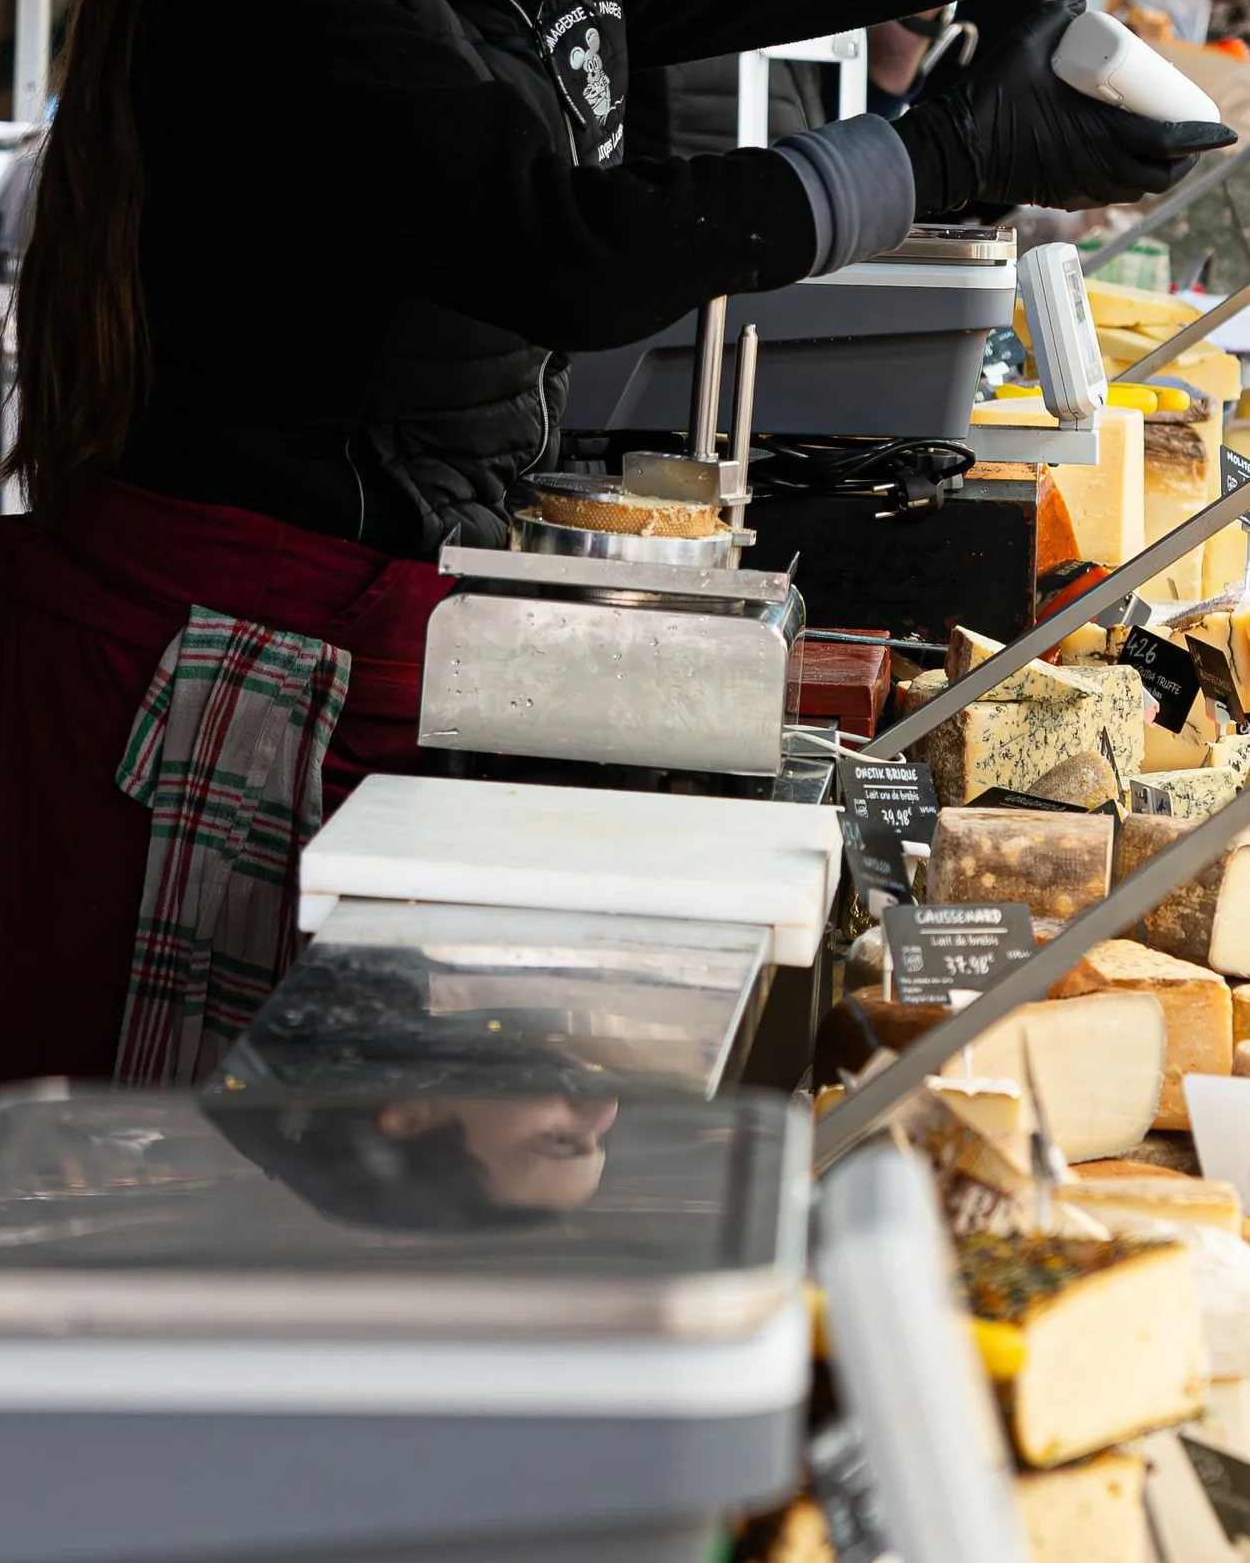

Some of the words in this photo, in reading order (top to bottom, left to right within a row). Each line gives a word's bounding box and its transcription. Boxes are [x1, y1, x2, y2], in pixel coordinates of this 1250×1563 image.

[546, 6, 587, 53] MAGERIE
[1126, 632, 1158, 664] 426
[855, 766, 885, 780] ONETIK
[885, 767, 919, 782] BRIQUE
[892, 789, 900, 801] de
[955, 934, 967, 947] de
[969, 935, 999, 947] brebis
